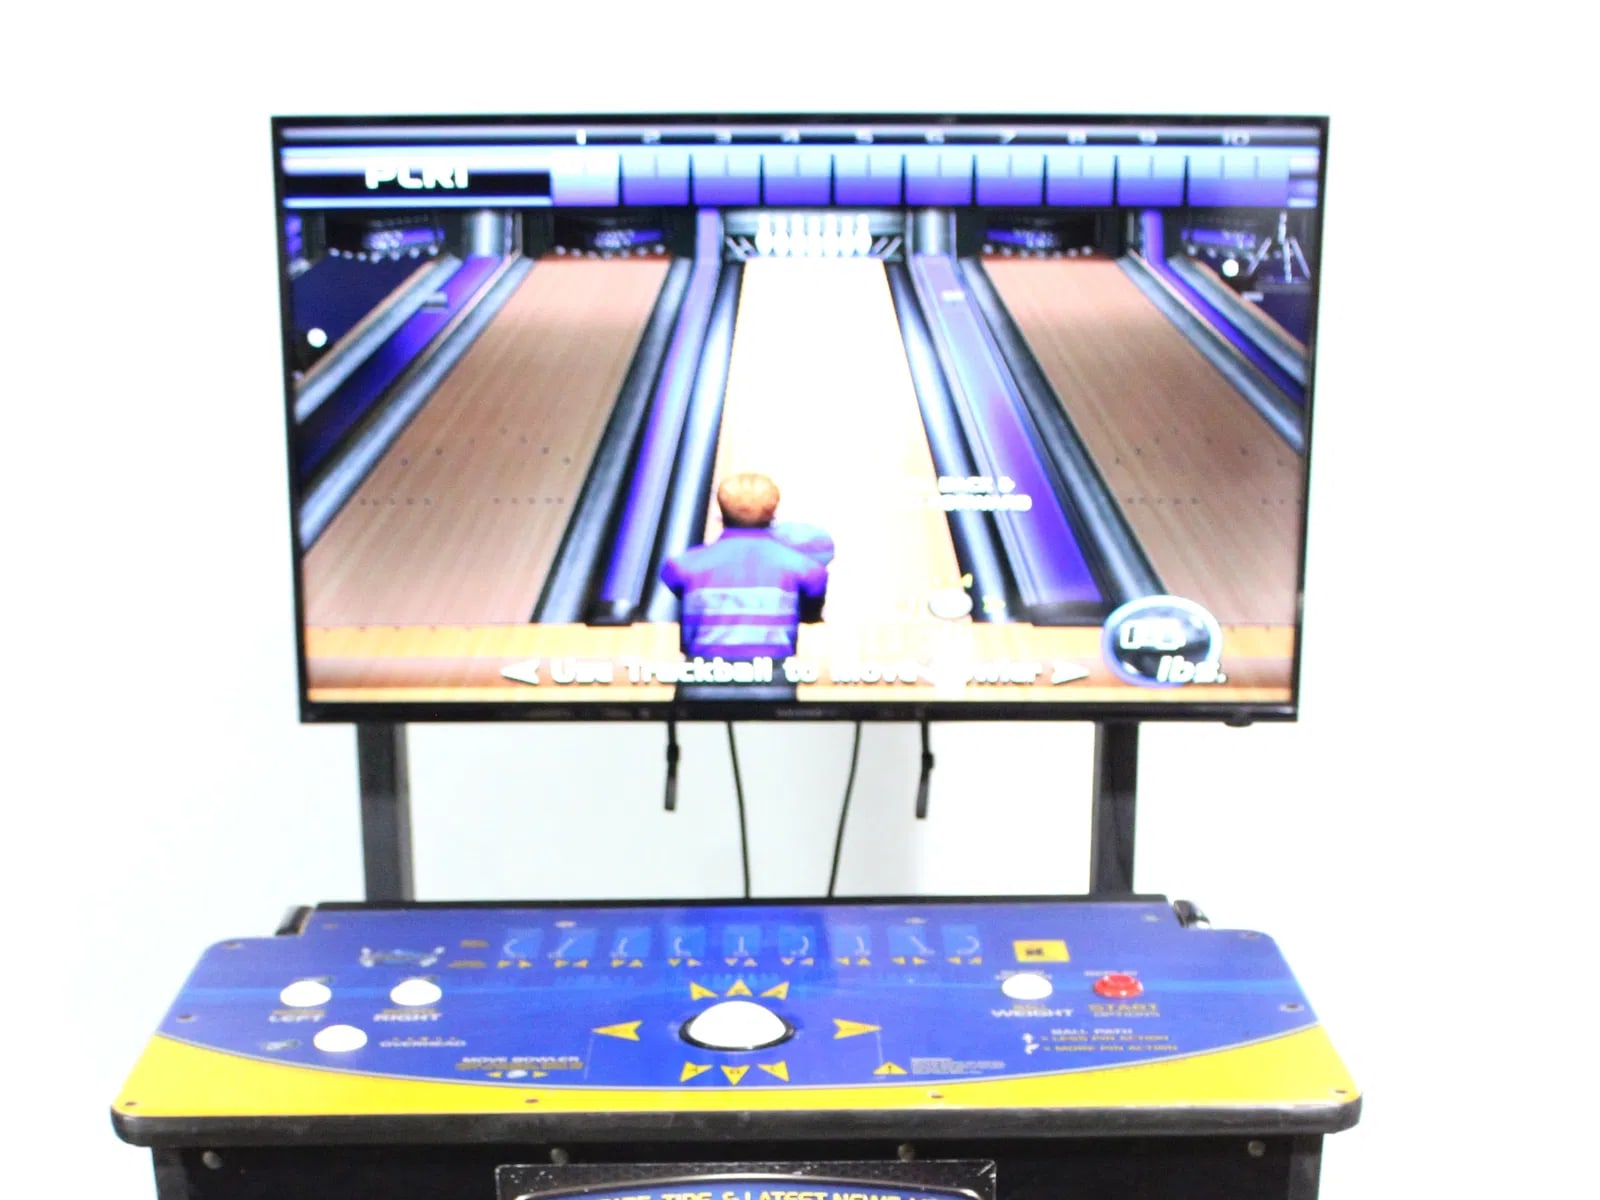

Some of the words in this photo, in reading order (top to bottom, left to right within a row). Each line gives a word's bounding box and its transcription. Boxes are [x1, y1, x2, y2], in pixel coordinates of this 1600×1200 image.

[624, 657, 773, 684] Trackball
[782, 657, 818, 684] to
[269, 1014, 326, 1023] LEFT
[372, 1013, 441, 1023] RIGHT
[991, 1008, 1075, 1018] WEIGHT
